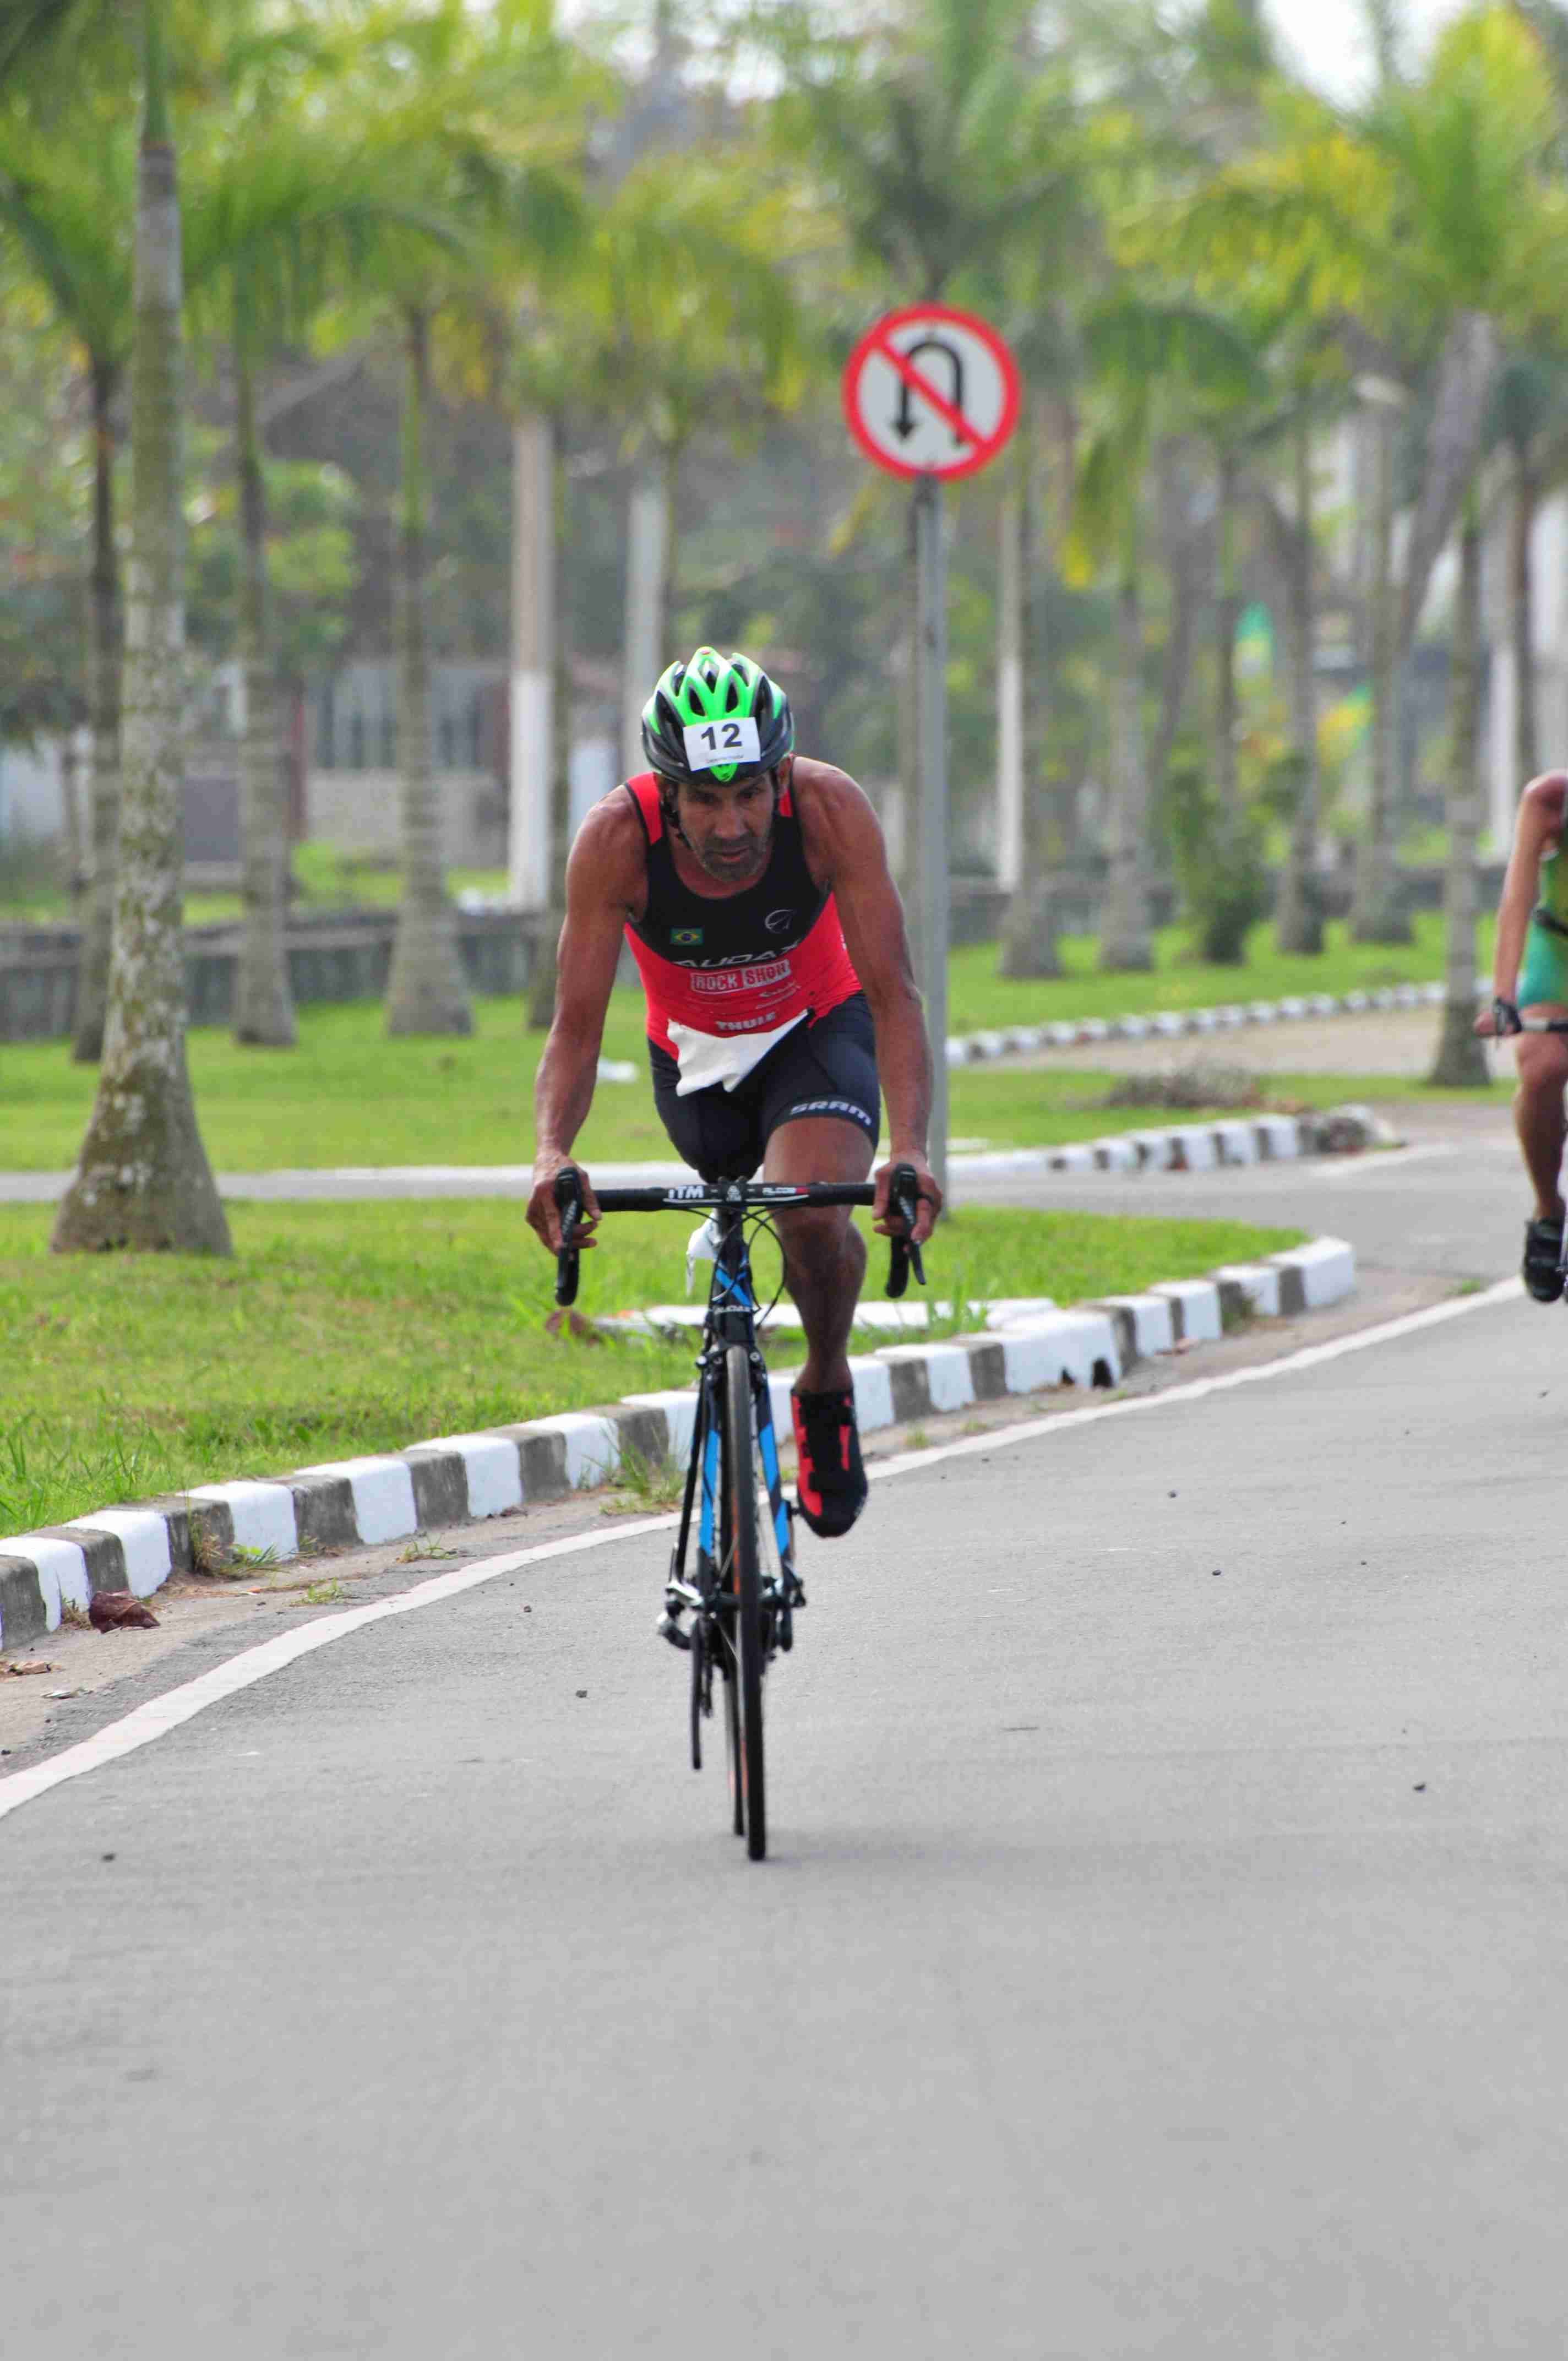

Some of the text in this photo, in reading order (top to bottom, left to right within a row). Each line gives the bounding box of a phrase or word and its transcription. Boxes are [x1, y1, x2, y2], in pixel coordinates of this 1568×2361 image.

[701, 723, 742, 750] 12
[695, 973, 738, 991] ROCK
[790, 1101, 872, 1125] SRAM
